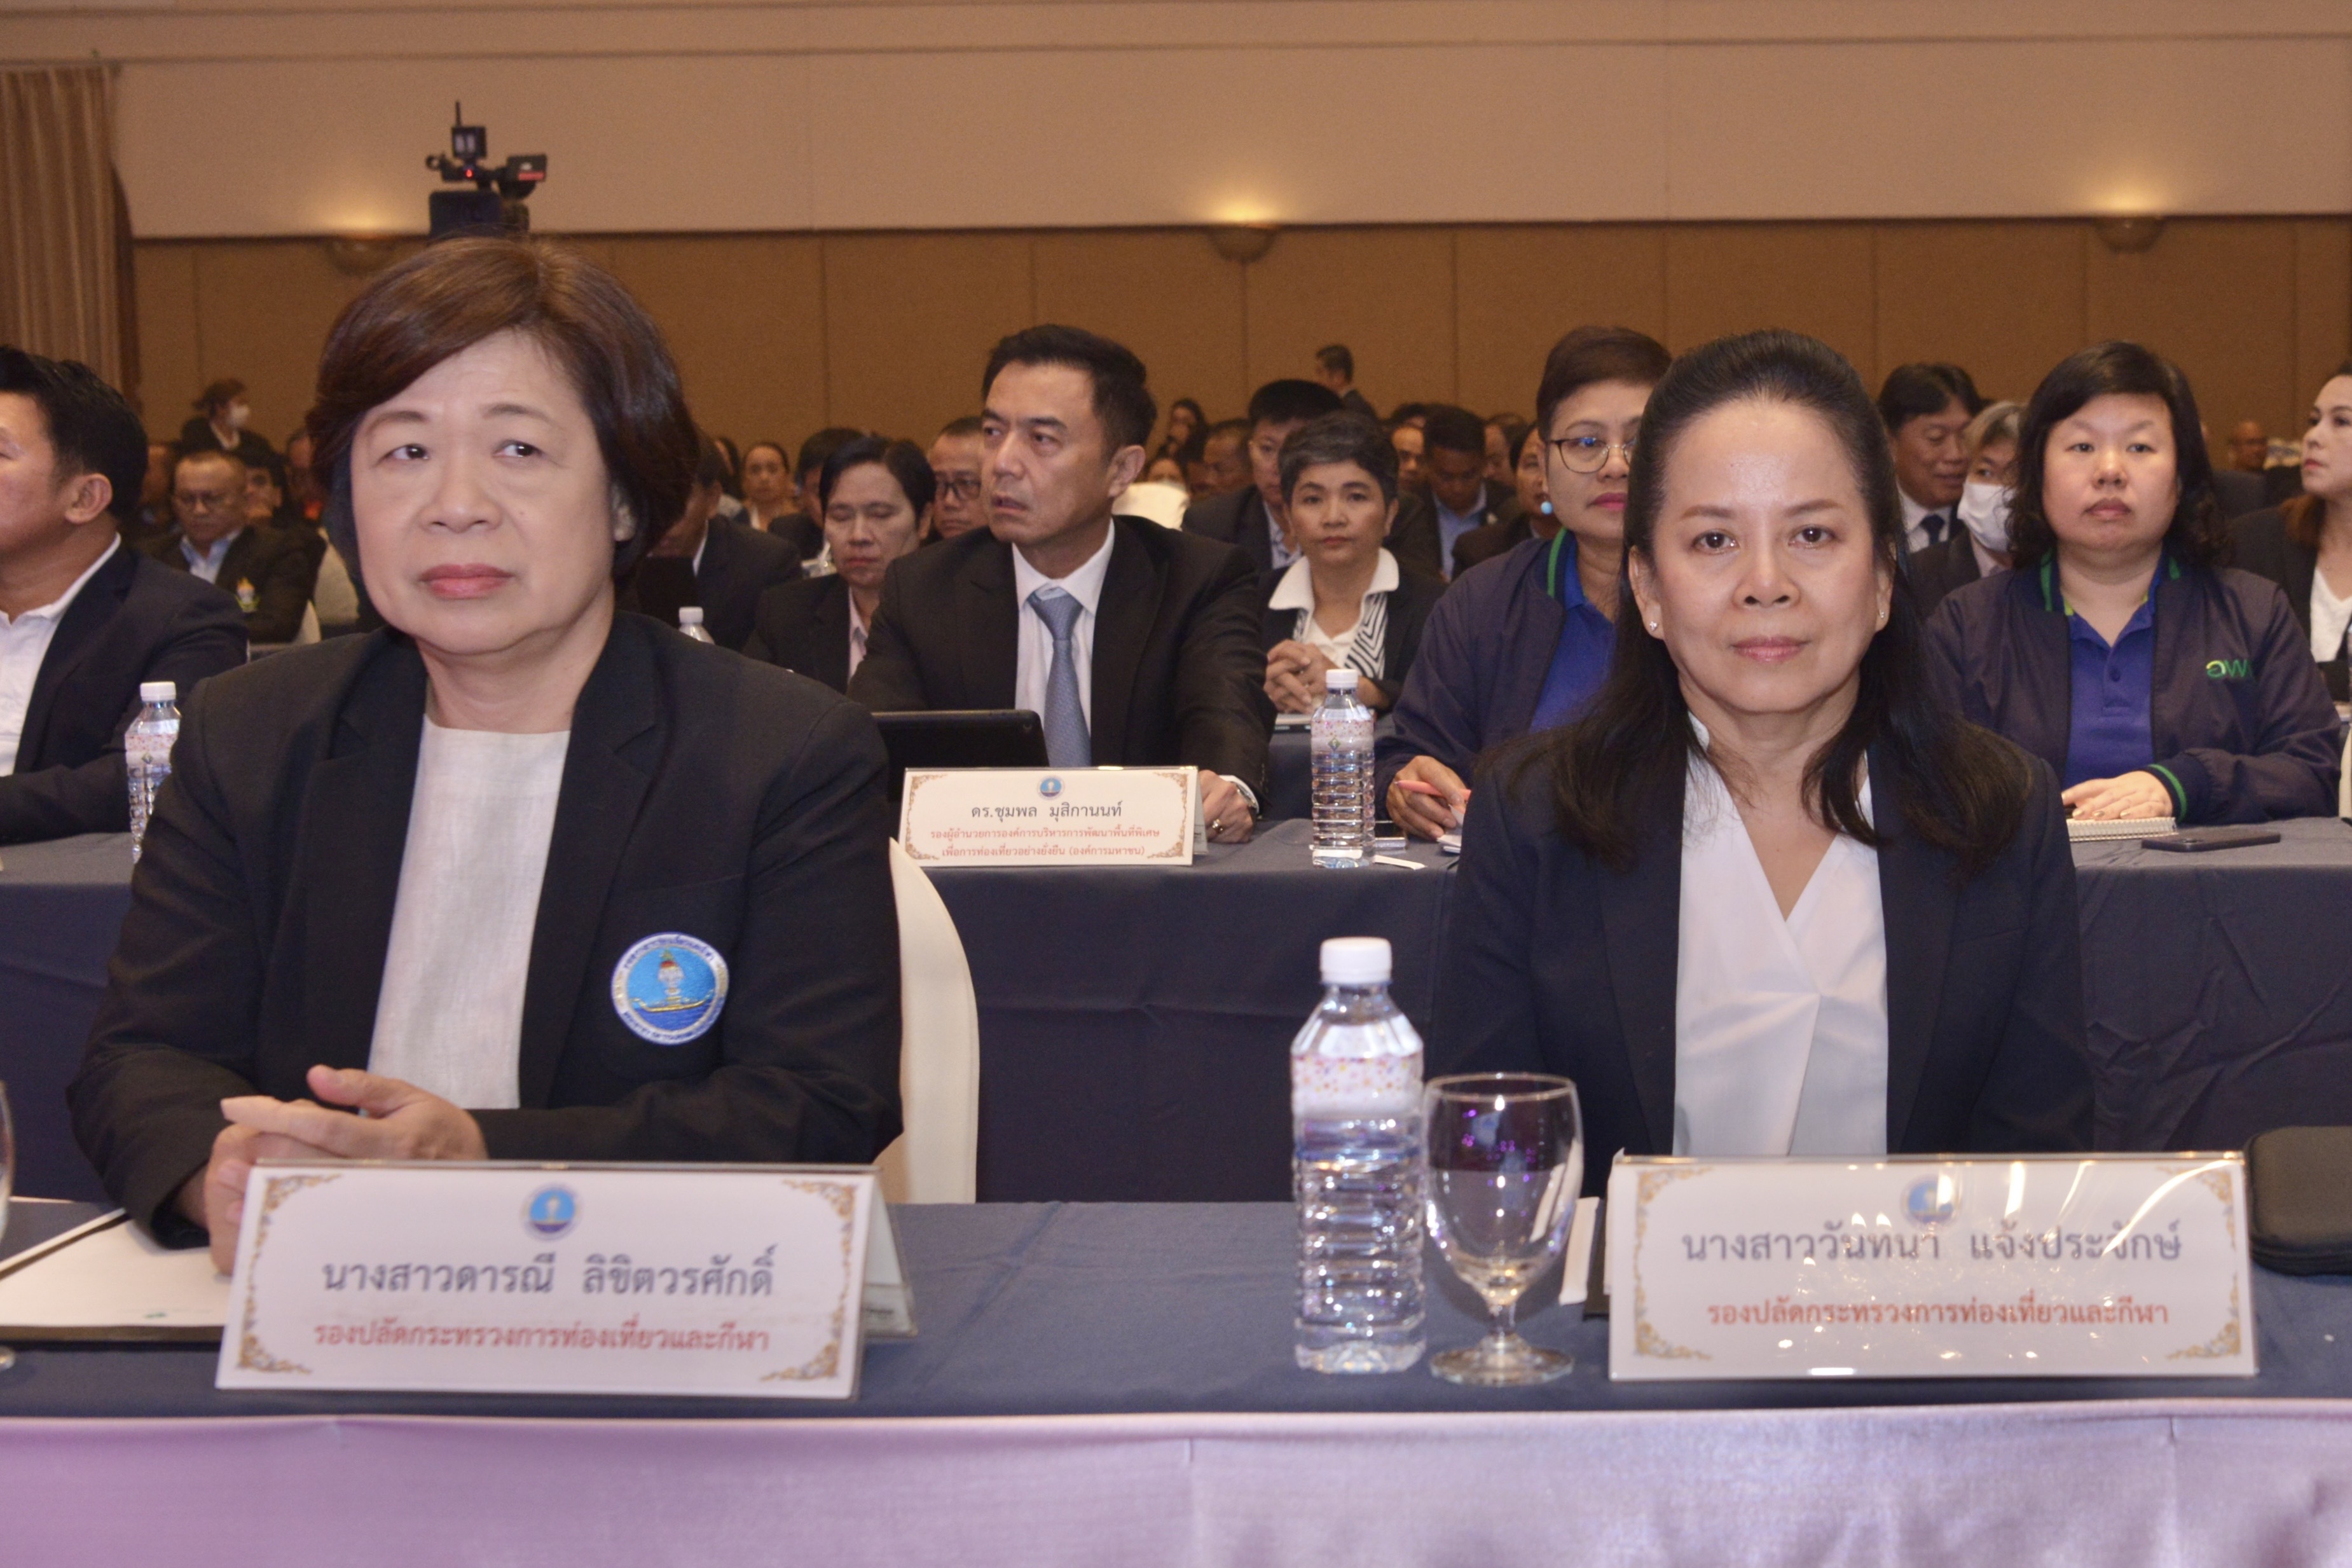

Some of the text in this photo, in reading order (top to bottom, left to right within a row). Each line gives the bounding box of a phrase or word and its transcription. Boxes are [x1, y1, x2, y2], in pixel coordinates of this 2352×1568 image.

[972, 801, 1123, 822] ดร.ชุมพล มุสิกานนท์
[942, 842, 1145, 856] เพื่อการท่องเที่ยวอย่างยั่งยืน (องค์การมหาชน)
[1681, 1218, 2182, 1262] นางสาววันทนา แจ้งประจักษ์
[322, 1243, 778, 1296] นางสาวดารณี ลิขิตวรศักดิ์
[1707, 1288, 2169, 1325] รองปลัดกระทรวงการท่องเที่ยวและกีฬา
[314, 1312, 771, 1351] รองปลัดกระทรวงการท่องเที่ยวและกีฬา
